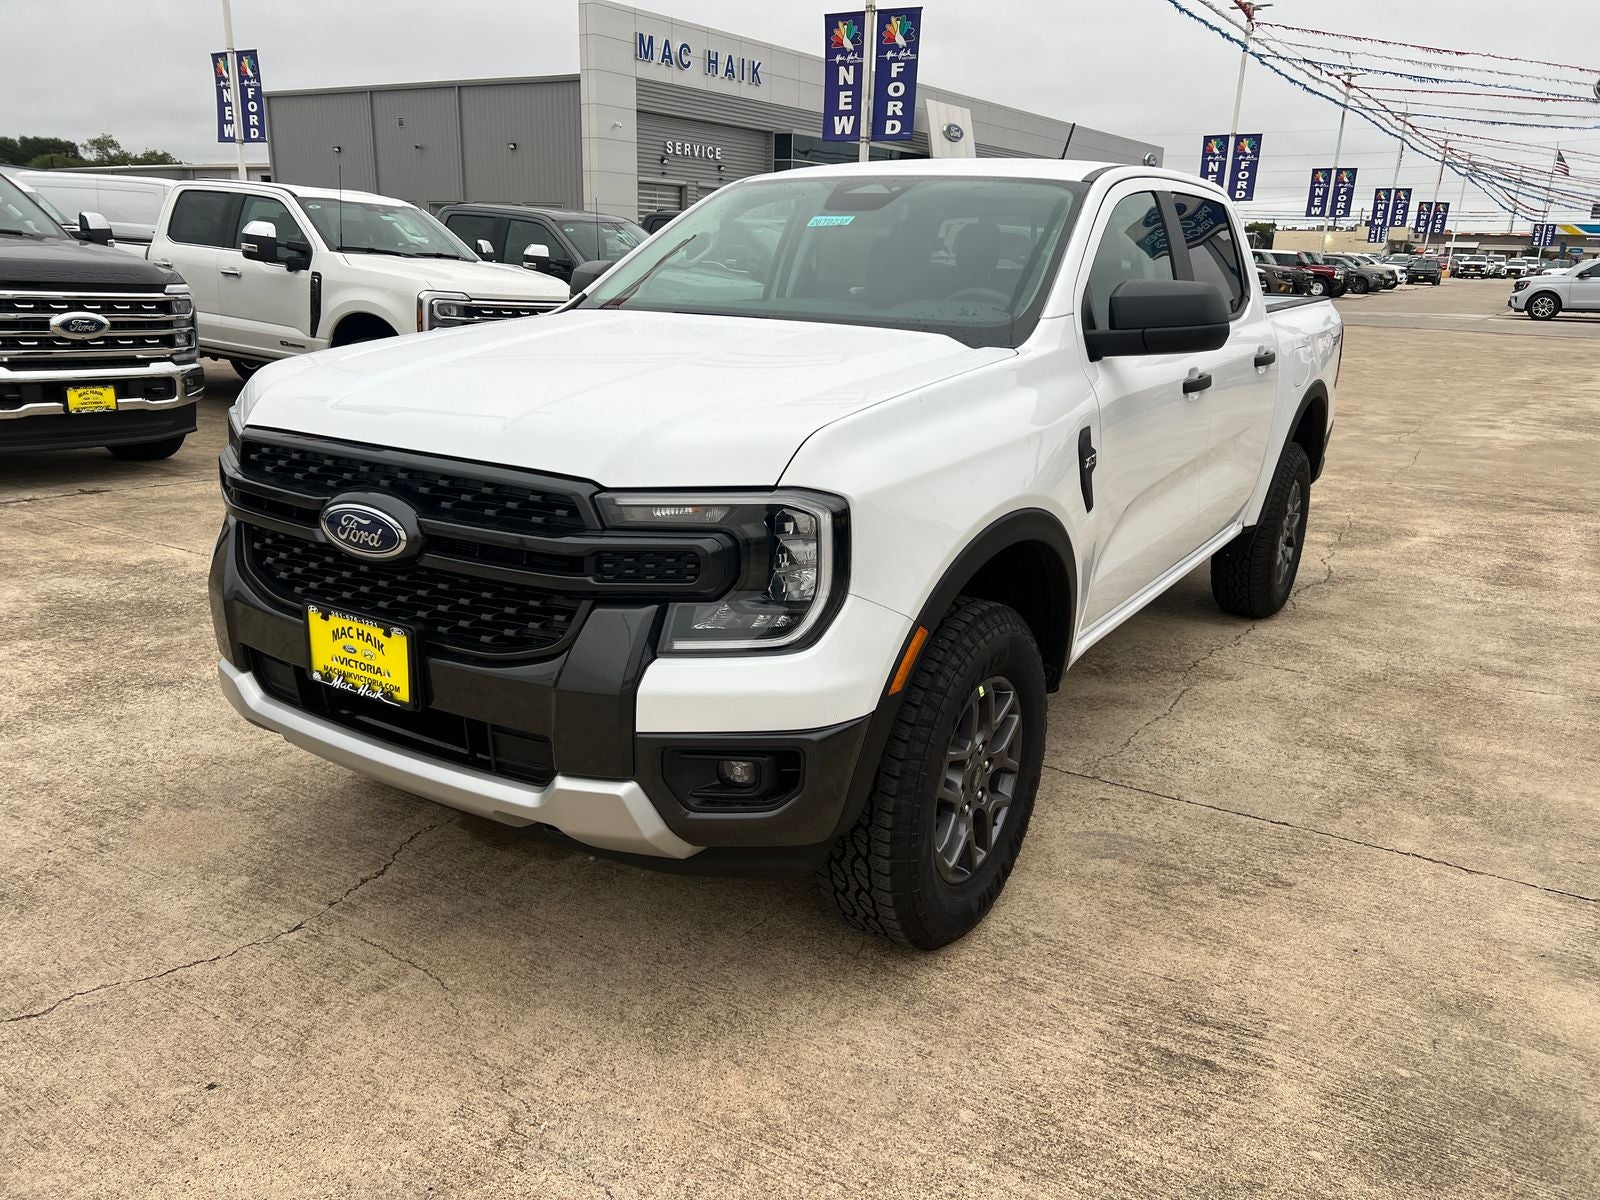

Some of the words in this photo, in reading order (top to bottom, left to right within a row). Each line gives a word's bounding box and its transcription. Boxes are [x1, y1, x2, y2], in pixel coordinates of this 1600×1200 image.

[635, 31, 691, 70] MAC
[704, 49, 761, 86] HAIK
[833, 65, 855, 135] NEW
[885, 62, 906, 135] FORD
[223, 88, 235, 138] NEW
[247, 87, 259, 139] FORD
[666, 140, 722, 160] SERVICE
[1234, 161, 1251, 199] FORD
[1310, 187, 1323, 215] NEW
[1335, 187, 1348, 216] FORD
[1374, 203, 1385, 226] NEW
[1394, 203, 1404, 226] FORD
[1417, 214, 1427, 233] NEW
[1434, 214, 1443, 233] FORD
[69, 319, 97, 332] Ford
[337, 513, 383, 548] Ford
[332, 626, 354, 643] MAC
[356, 627, 386, 657] HAIK
[338, 655, 384, 677] VICTORIA
[329, 674, 357, 693] Mac
